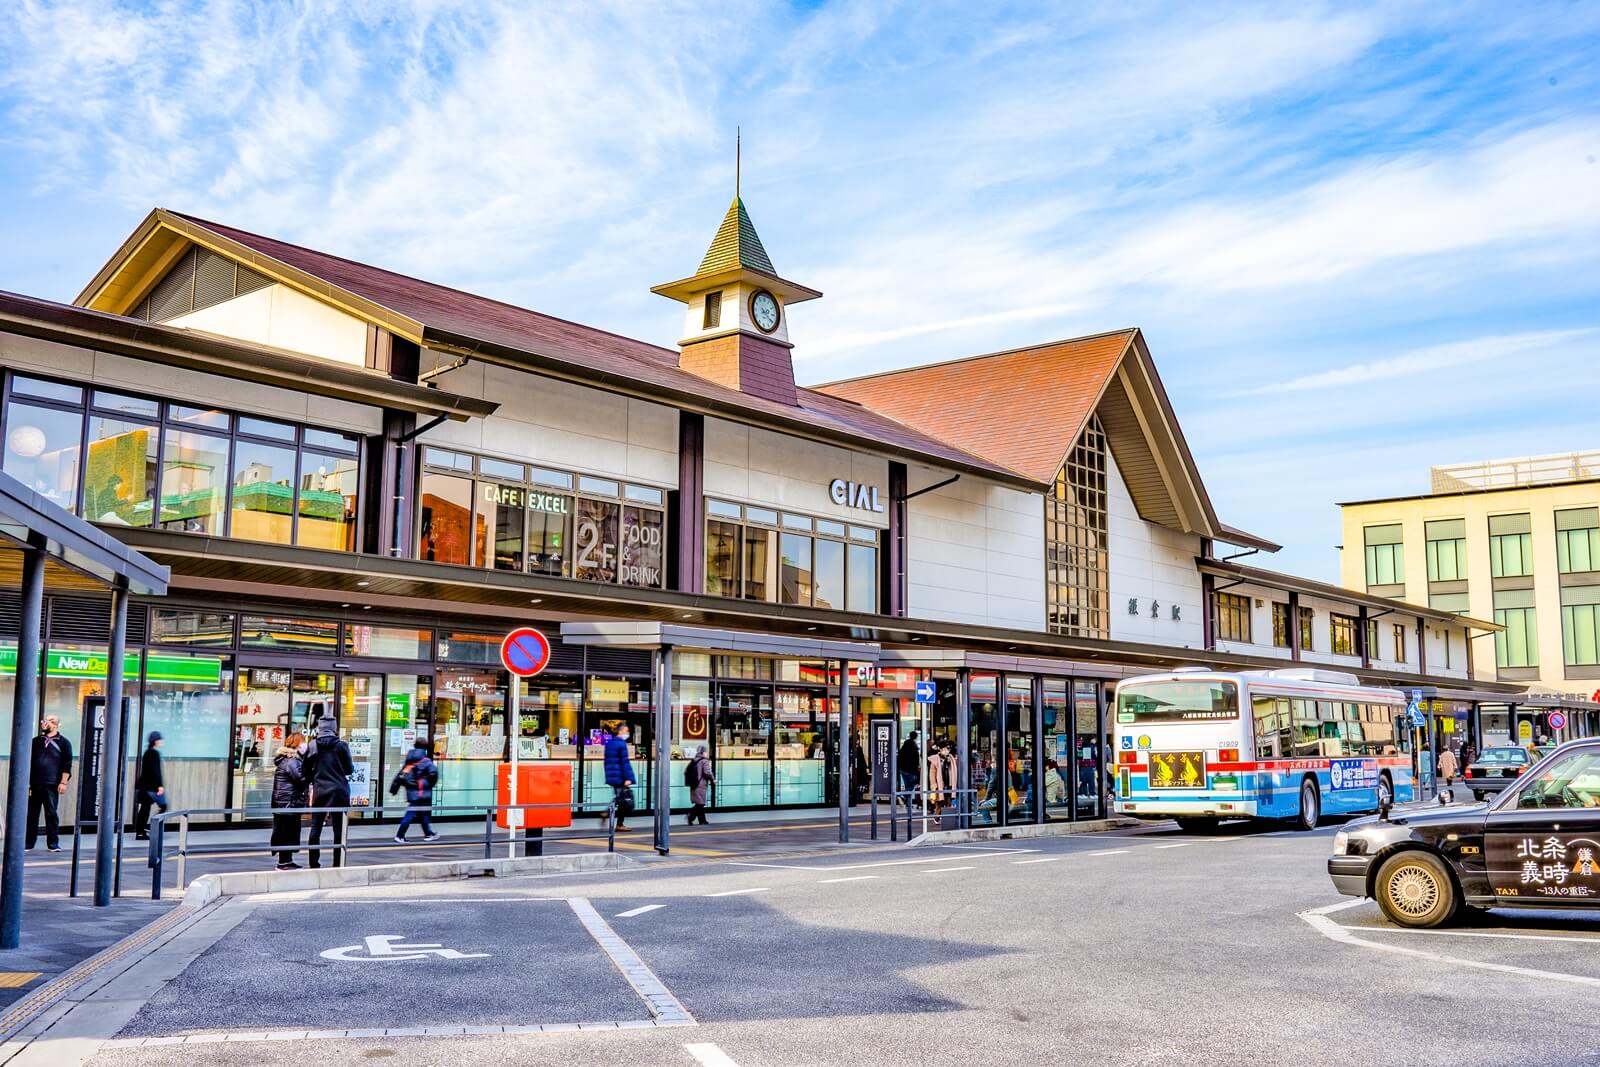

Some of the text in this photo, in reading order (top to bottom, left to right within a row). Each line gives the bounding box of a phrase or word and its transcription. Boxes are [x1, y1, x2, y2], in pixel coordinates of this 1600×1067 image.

[484, 486, 518, 506] CAFE
[829, 478, 884, 513] CIAL
[623, 524, 660, 545] FOOD
[579, 522, 615, 569] 2F
[623, 546, 631, 560] &
[621, 564, 660, 585] DRINK
[58, 656, 108, 671] NewDa
[857, 667, 885, 681] CIAL
[1517, 836, 1568, 859] 北条
[1521, 861, 1570, 884] 義時
[1577, 848, 1593, 876] 鎌倉
[1496, 887, 1518, 896] TAXI
